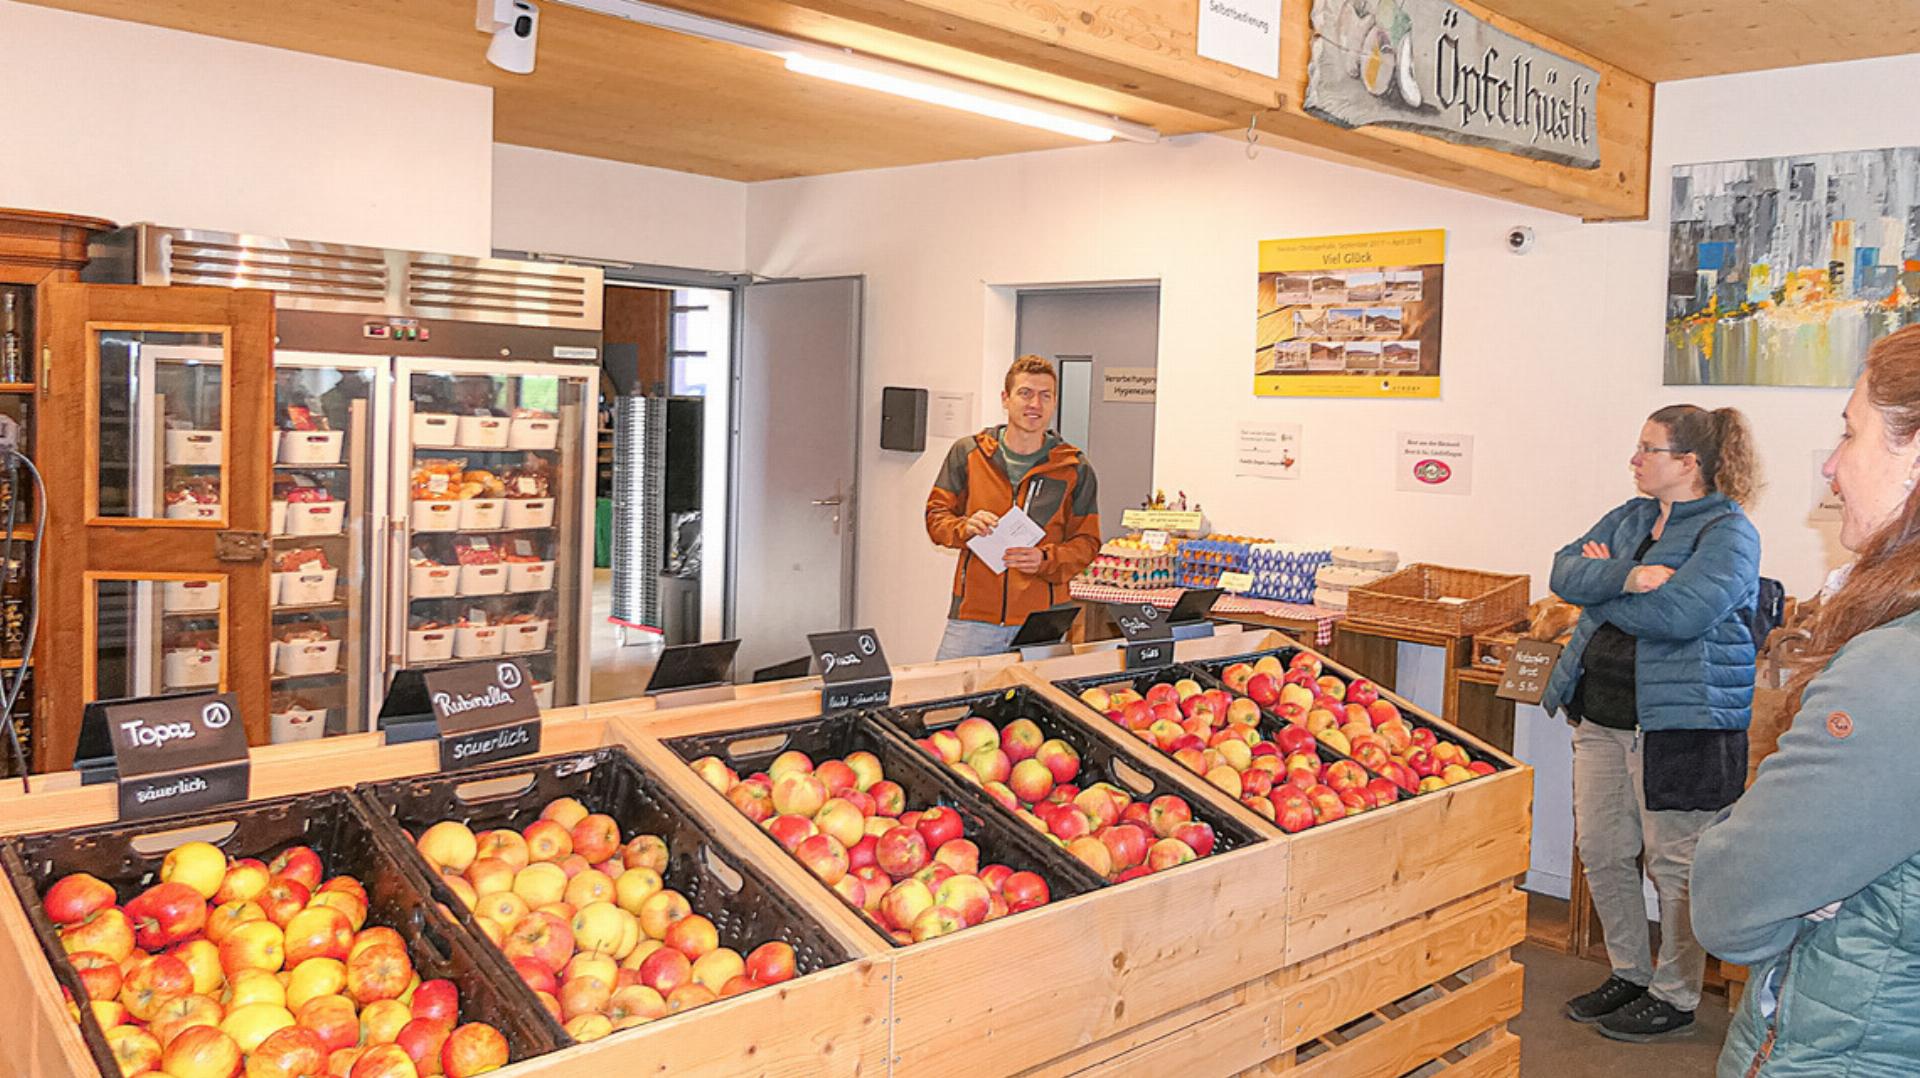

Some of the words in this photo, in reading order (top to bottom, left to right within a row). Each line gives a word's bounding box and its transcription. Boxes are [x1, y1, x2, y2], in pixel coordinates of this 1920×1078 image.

[1433, 8, 1591, 147] Öpfelhüsli
[1322, 254, 1341, 265] Viel
[1343, 252, 1373, 264] Glück
[433, 684, 515, 718] Rubinella
[121, 719, 196, 748] Topaz
[453, 724, 530, 760] säuerlich
[136, 777, 209, 804] säuerlich
